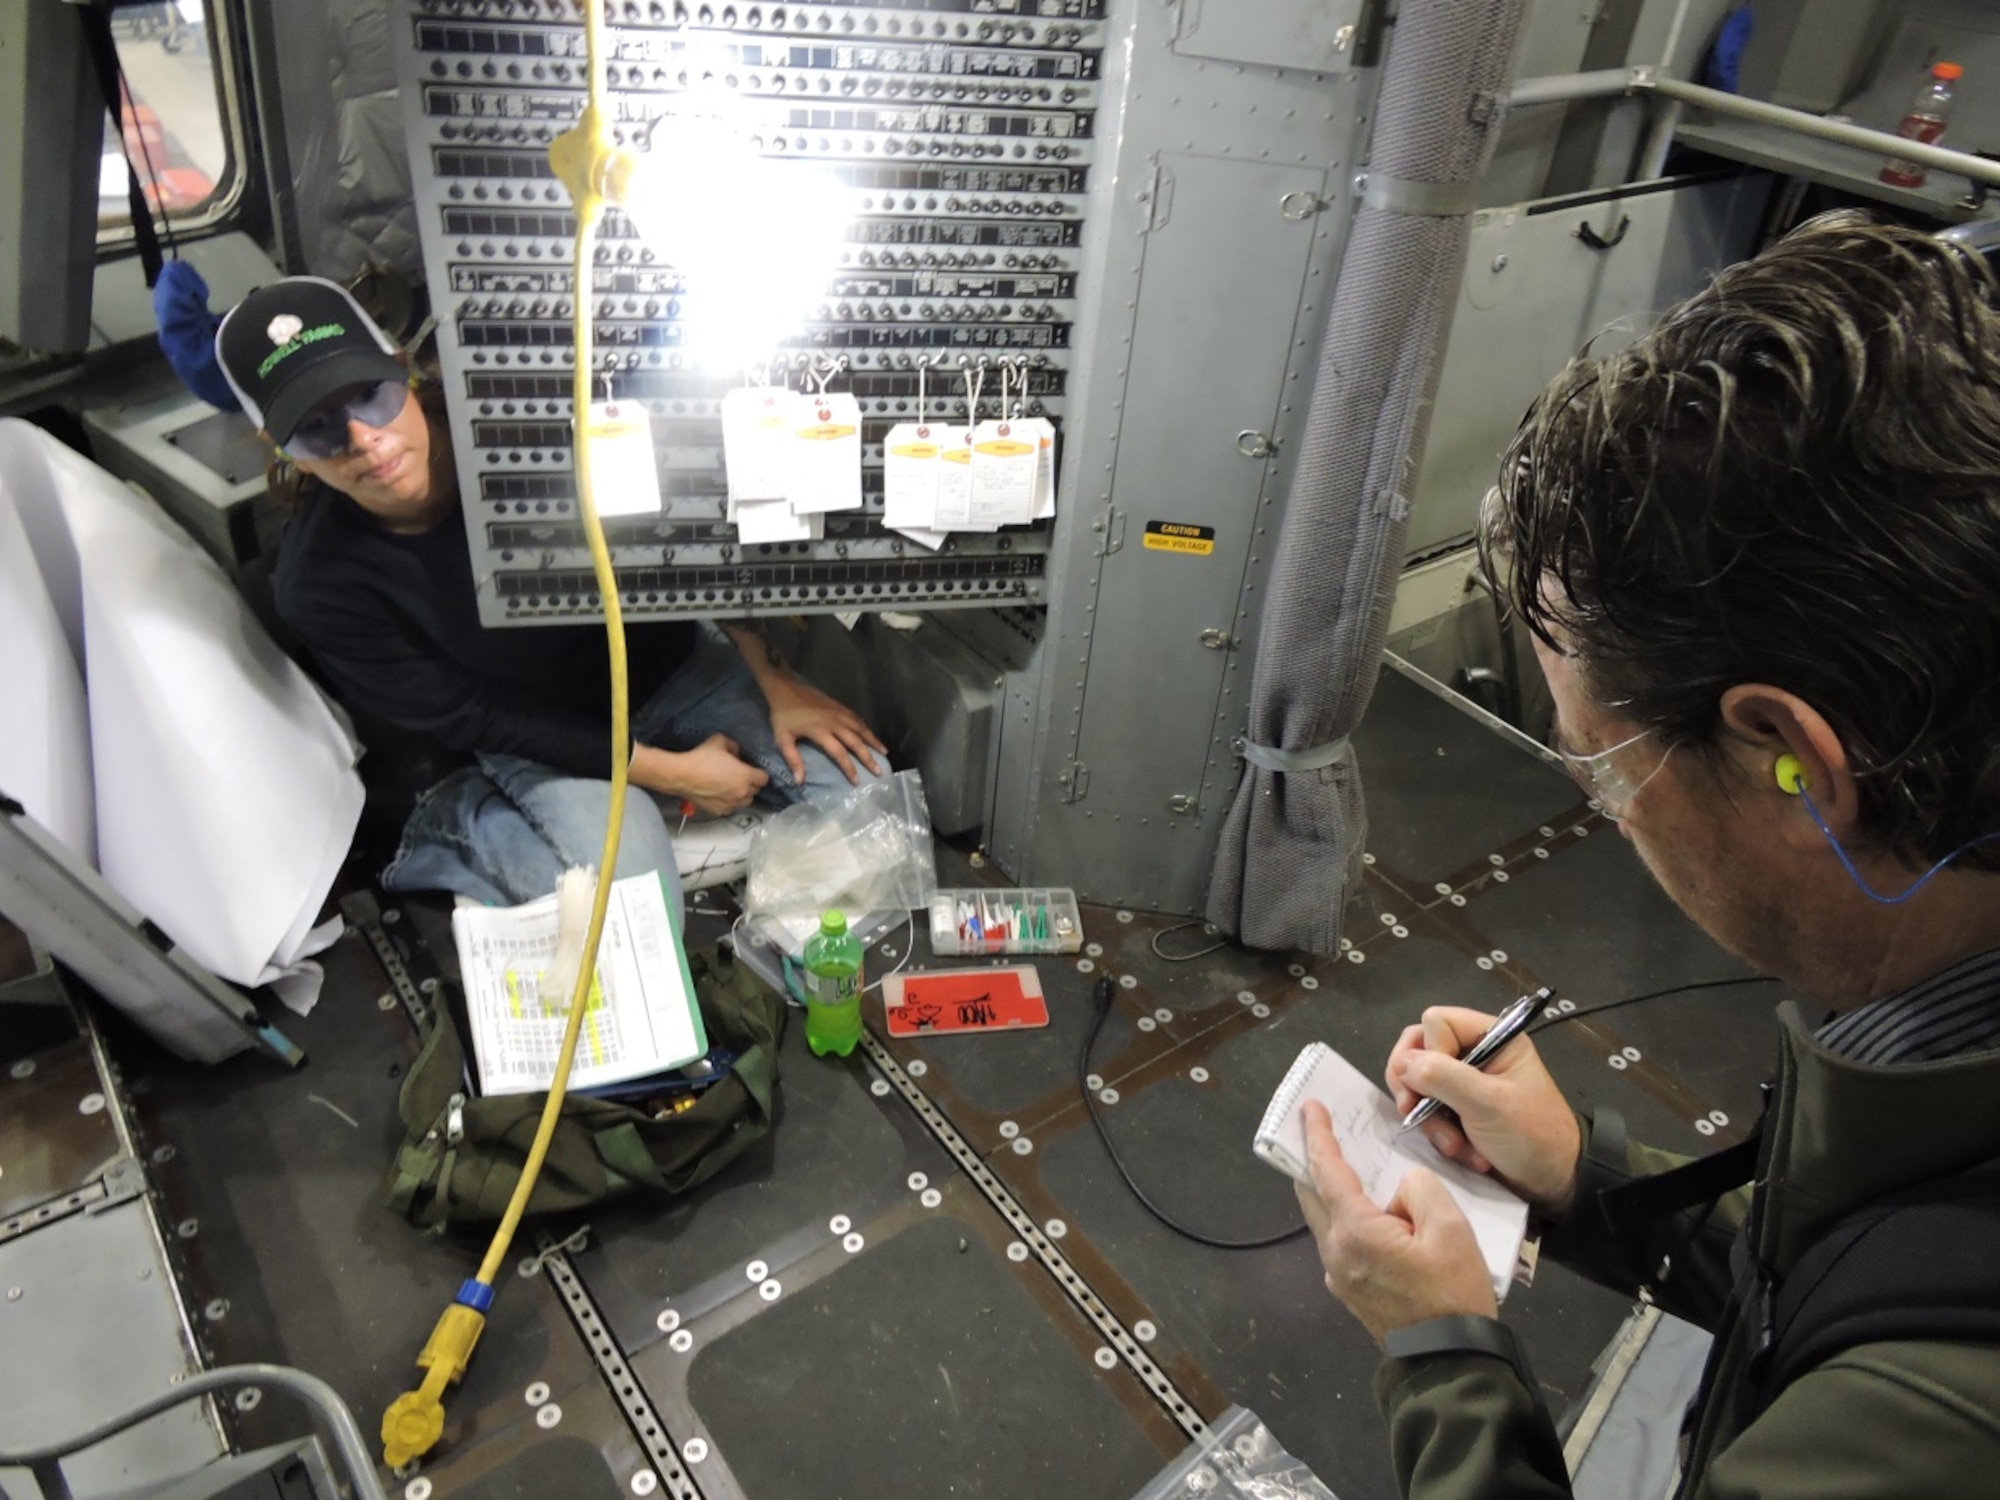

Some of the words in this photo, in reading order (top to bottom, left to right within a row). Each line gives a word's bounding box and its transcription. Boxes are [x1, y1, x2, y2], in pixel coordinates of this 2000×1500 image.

[1160, 523, 1201, 537] CAUTION
[1148, 537, 1169, 547] HIGH
[1172, 540, 1208, 551] VOLTAGE
